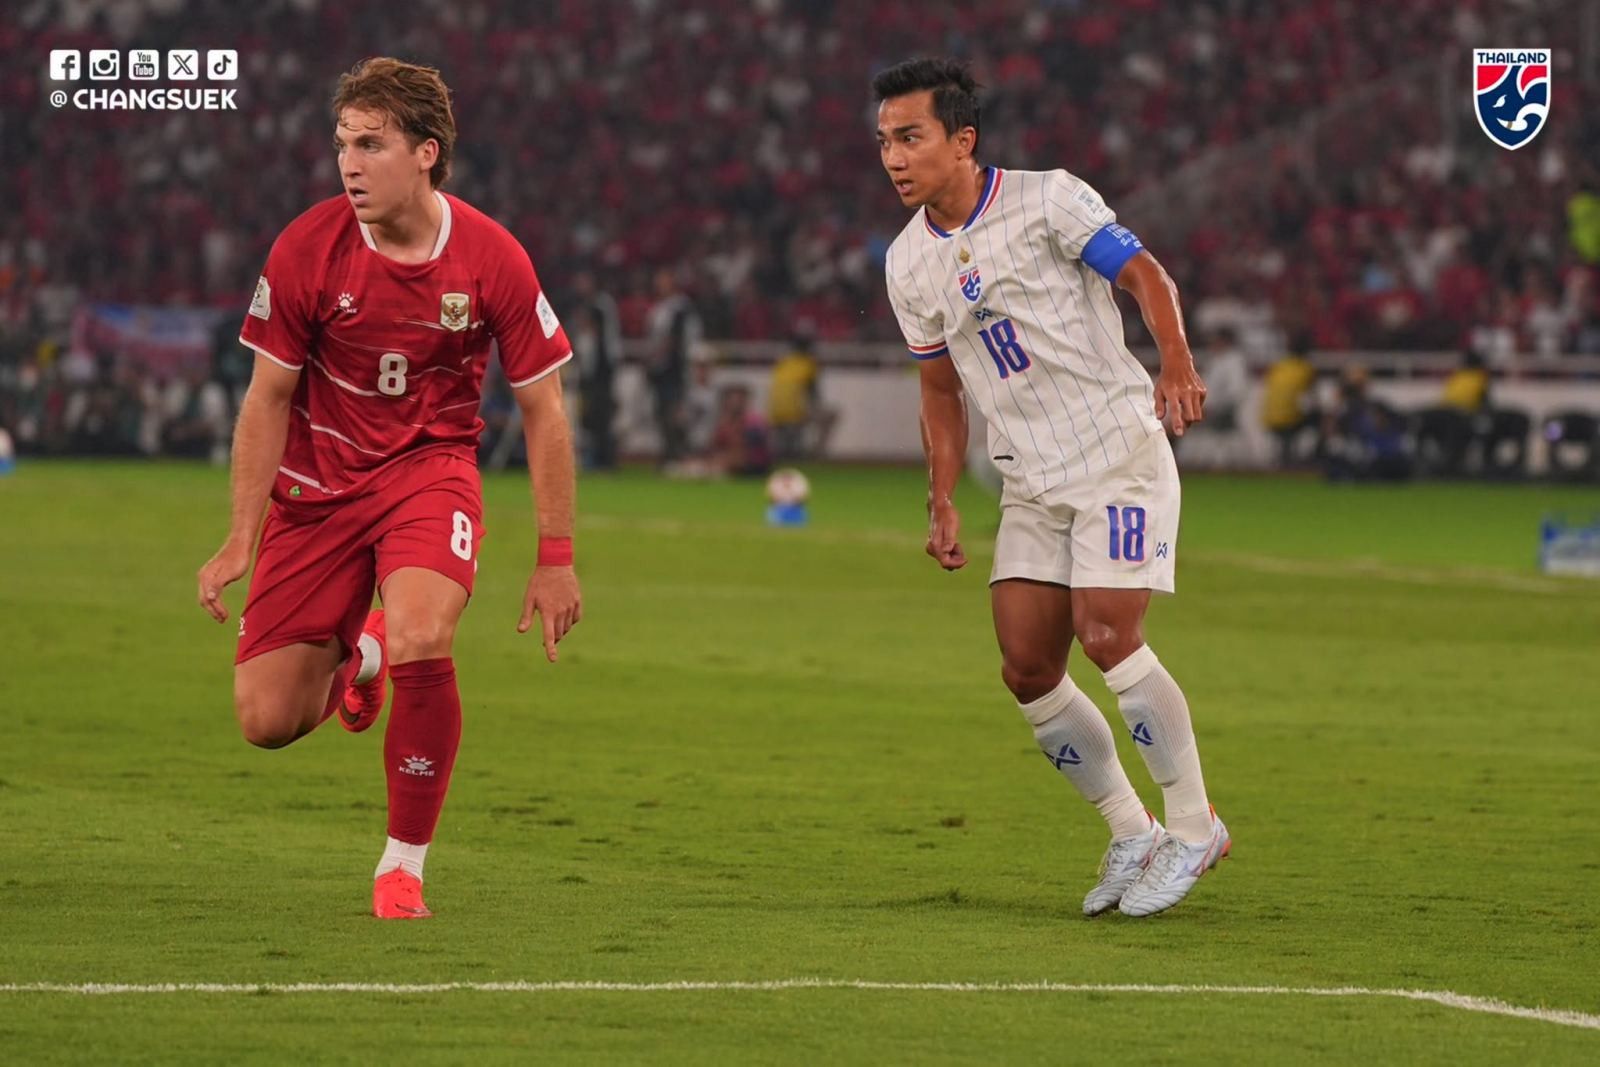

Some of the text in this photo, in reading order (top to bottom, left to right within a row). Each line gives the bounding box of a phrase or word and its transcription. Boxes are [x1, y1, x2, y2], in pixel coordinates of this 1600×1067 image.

[377, 352, 409, 396] 8
[977, 318, 1032, 380] 18
[450, 510, 473, 561] 8
[1105, 505, 1146, 562] 18
